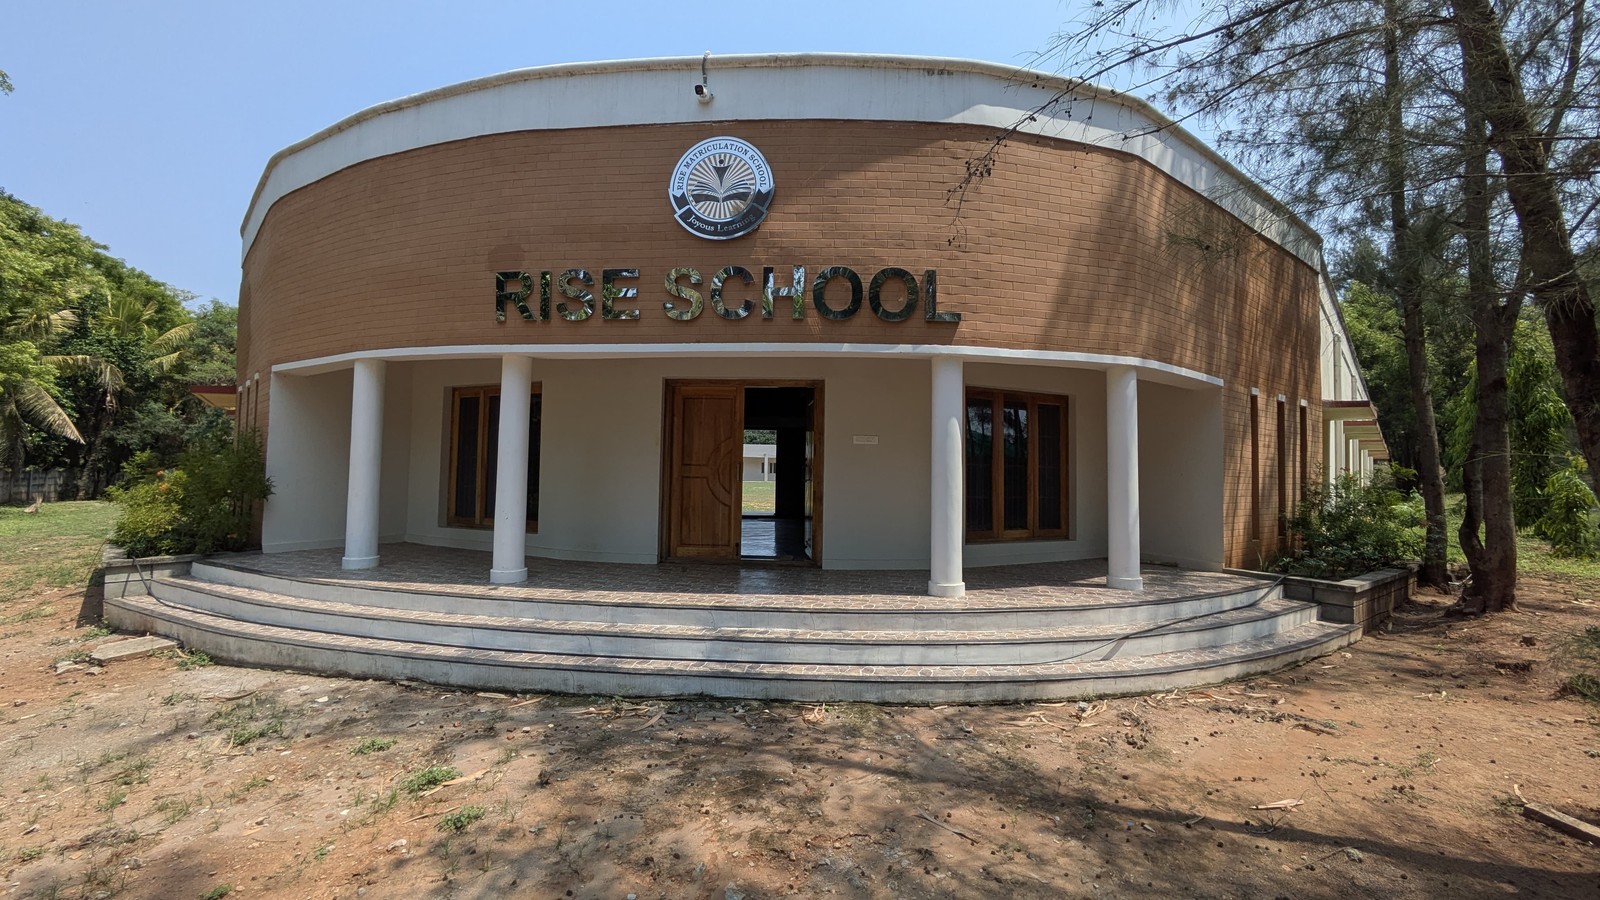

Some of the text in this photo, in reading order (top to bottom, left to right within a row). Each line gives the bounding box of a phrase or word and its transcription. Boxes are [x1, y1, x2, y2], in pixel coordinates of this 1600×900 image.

[677, 143, 766, 190] RISE MATRICULATION SCHOOL
[687, 214, 756, 231] Joyous Learning
[495, 264, 962, 323] RISE SCHOOL
